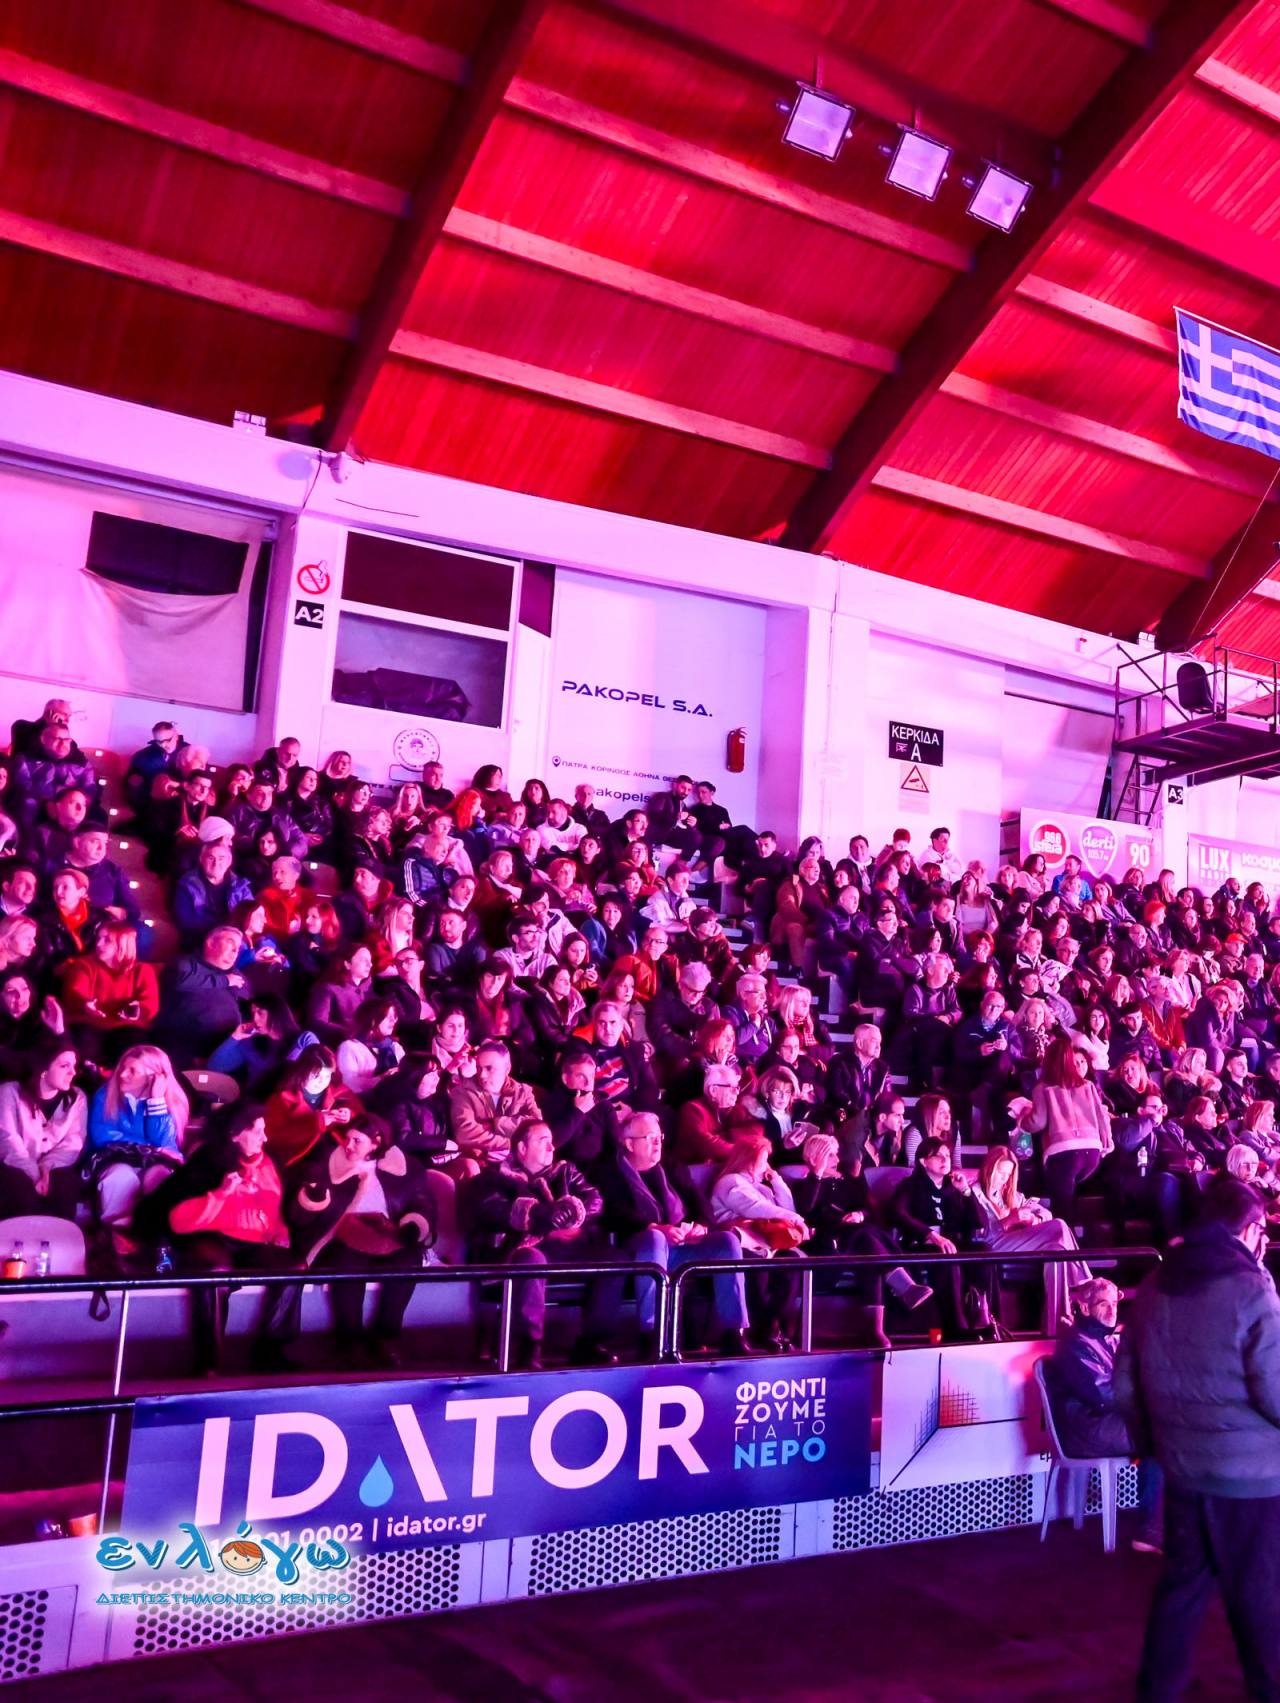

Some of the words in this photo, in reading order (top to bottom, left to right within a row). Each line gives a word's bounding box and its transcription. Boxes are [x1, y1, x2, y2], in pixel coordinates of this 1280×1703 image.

[562, 680, 666, 709] PAKOPEL
[672, 700, 713, 717] S.A.
[891, 725, 940, 746] ΚΕΡΚΙΔΑ
[910, 743, 922, 762] Α
[1200, 846, 1230, 873] LUX
[735, 1377, 826, 1403] ΦΡΟΝΤΙ
[734, 1398, 826, 1424] ΖΟΥΜΕ
[734, 1424, 777, 1442] ΓΙΑ
[793, 1419, 825, 1437] ΤΟ
[734, 1437, 826, 1470] ΝΕΡΟ
[386, 1512, 487, 1538] idator.gr
